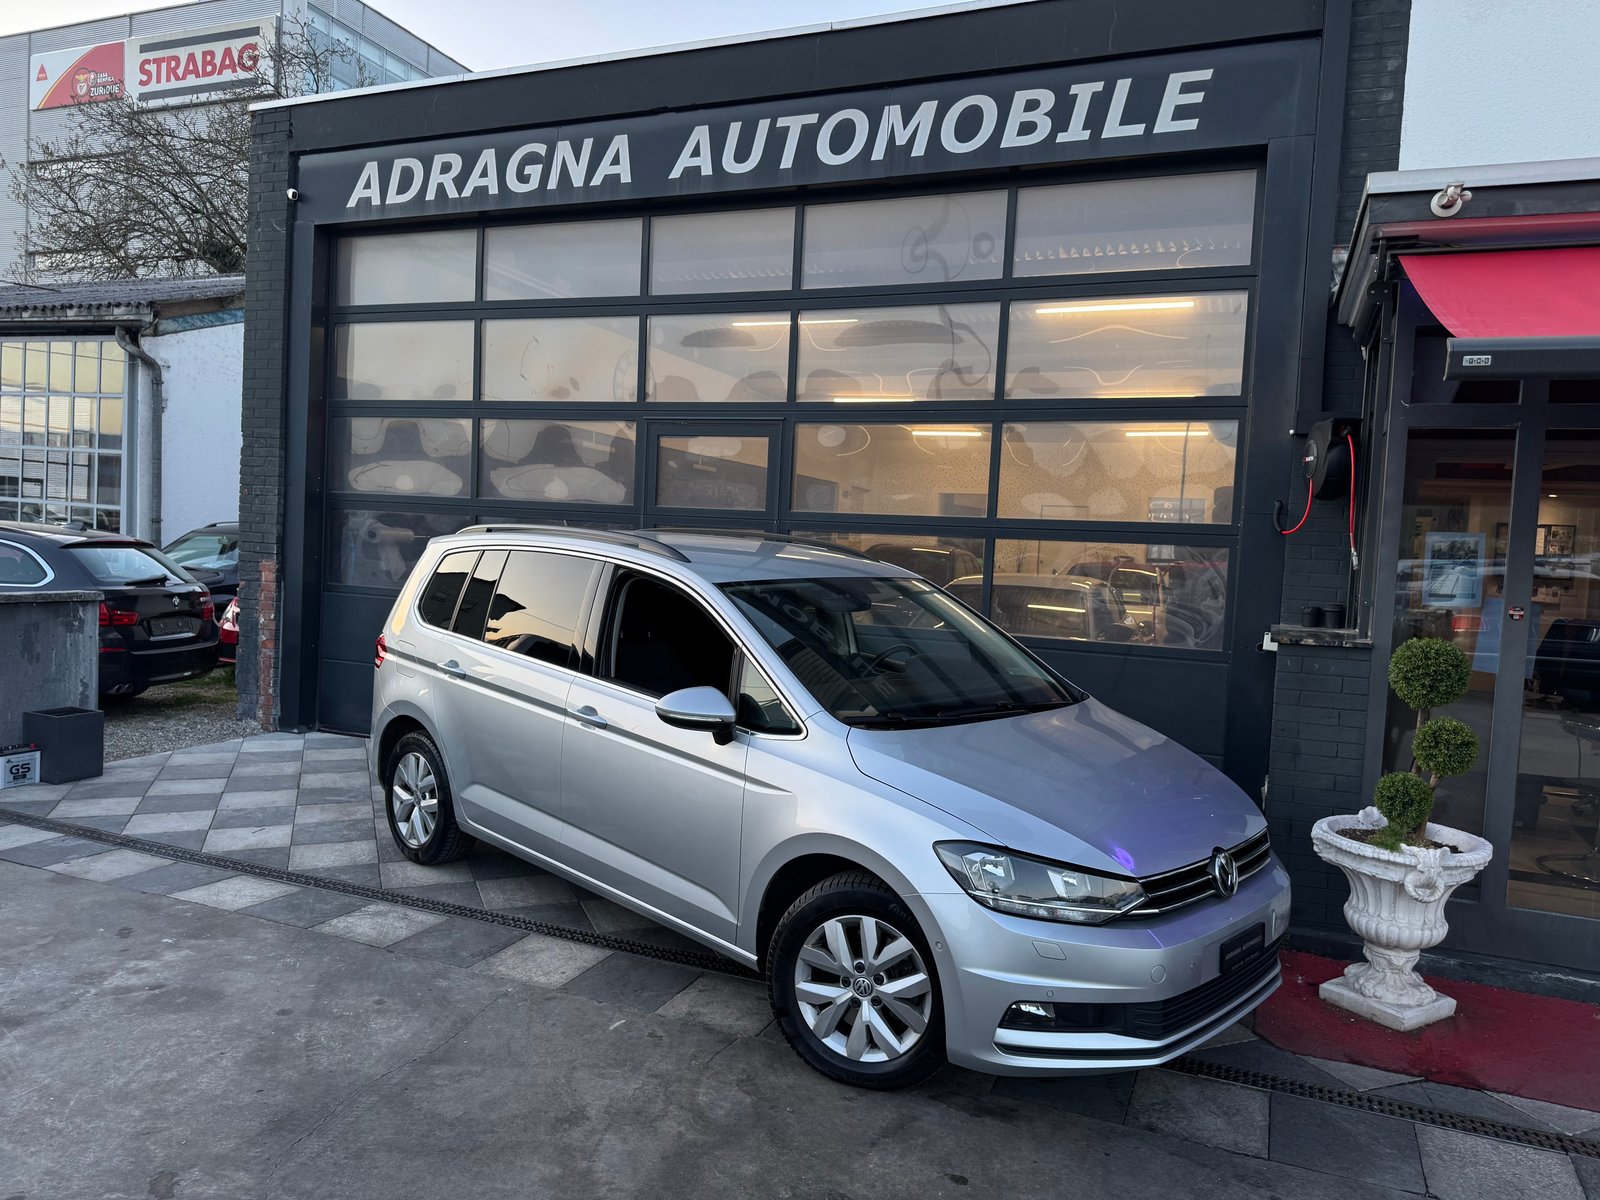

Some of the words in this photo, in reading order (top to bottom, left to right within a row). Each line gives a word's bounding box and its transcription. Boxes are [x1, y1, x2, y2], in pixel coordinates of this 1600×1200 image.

[138, 42, 260, 87] STRABAG
[346, 134, 632, 208] ADRAGNA
[668, 69, 1214, 179] AUTOMOBILE
[9, 762, 31, 775] GS
